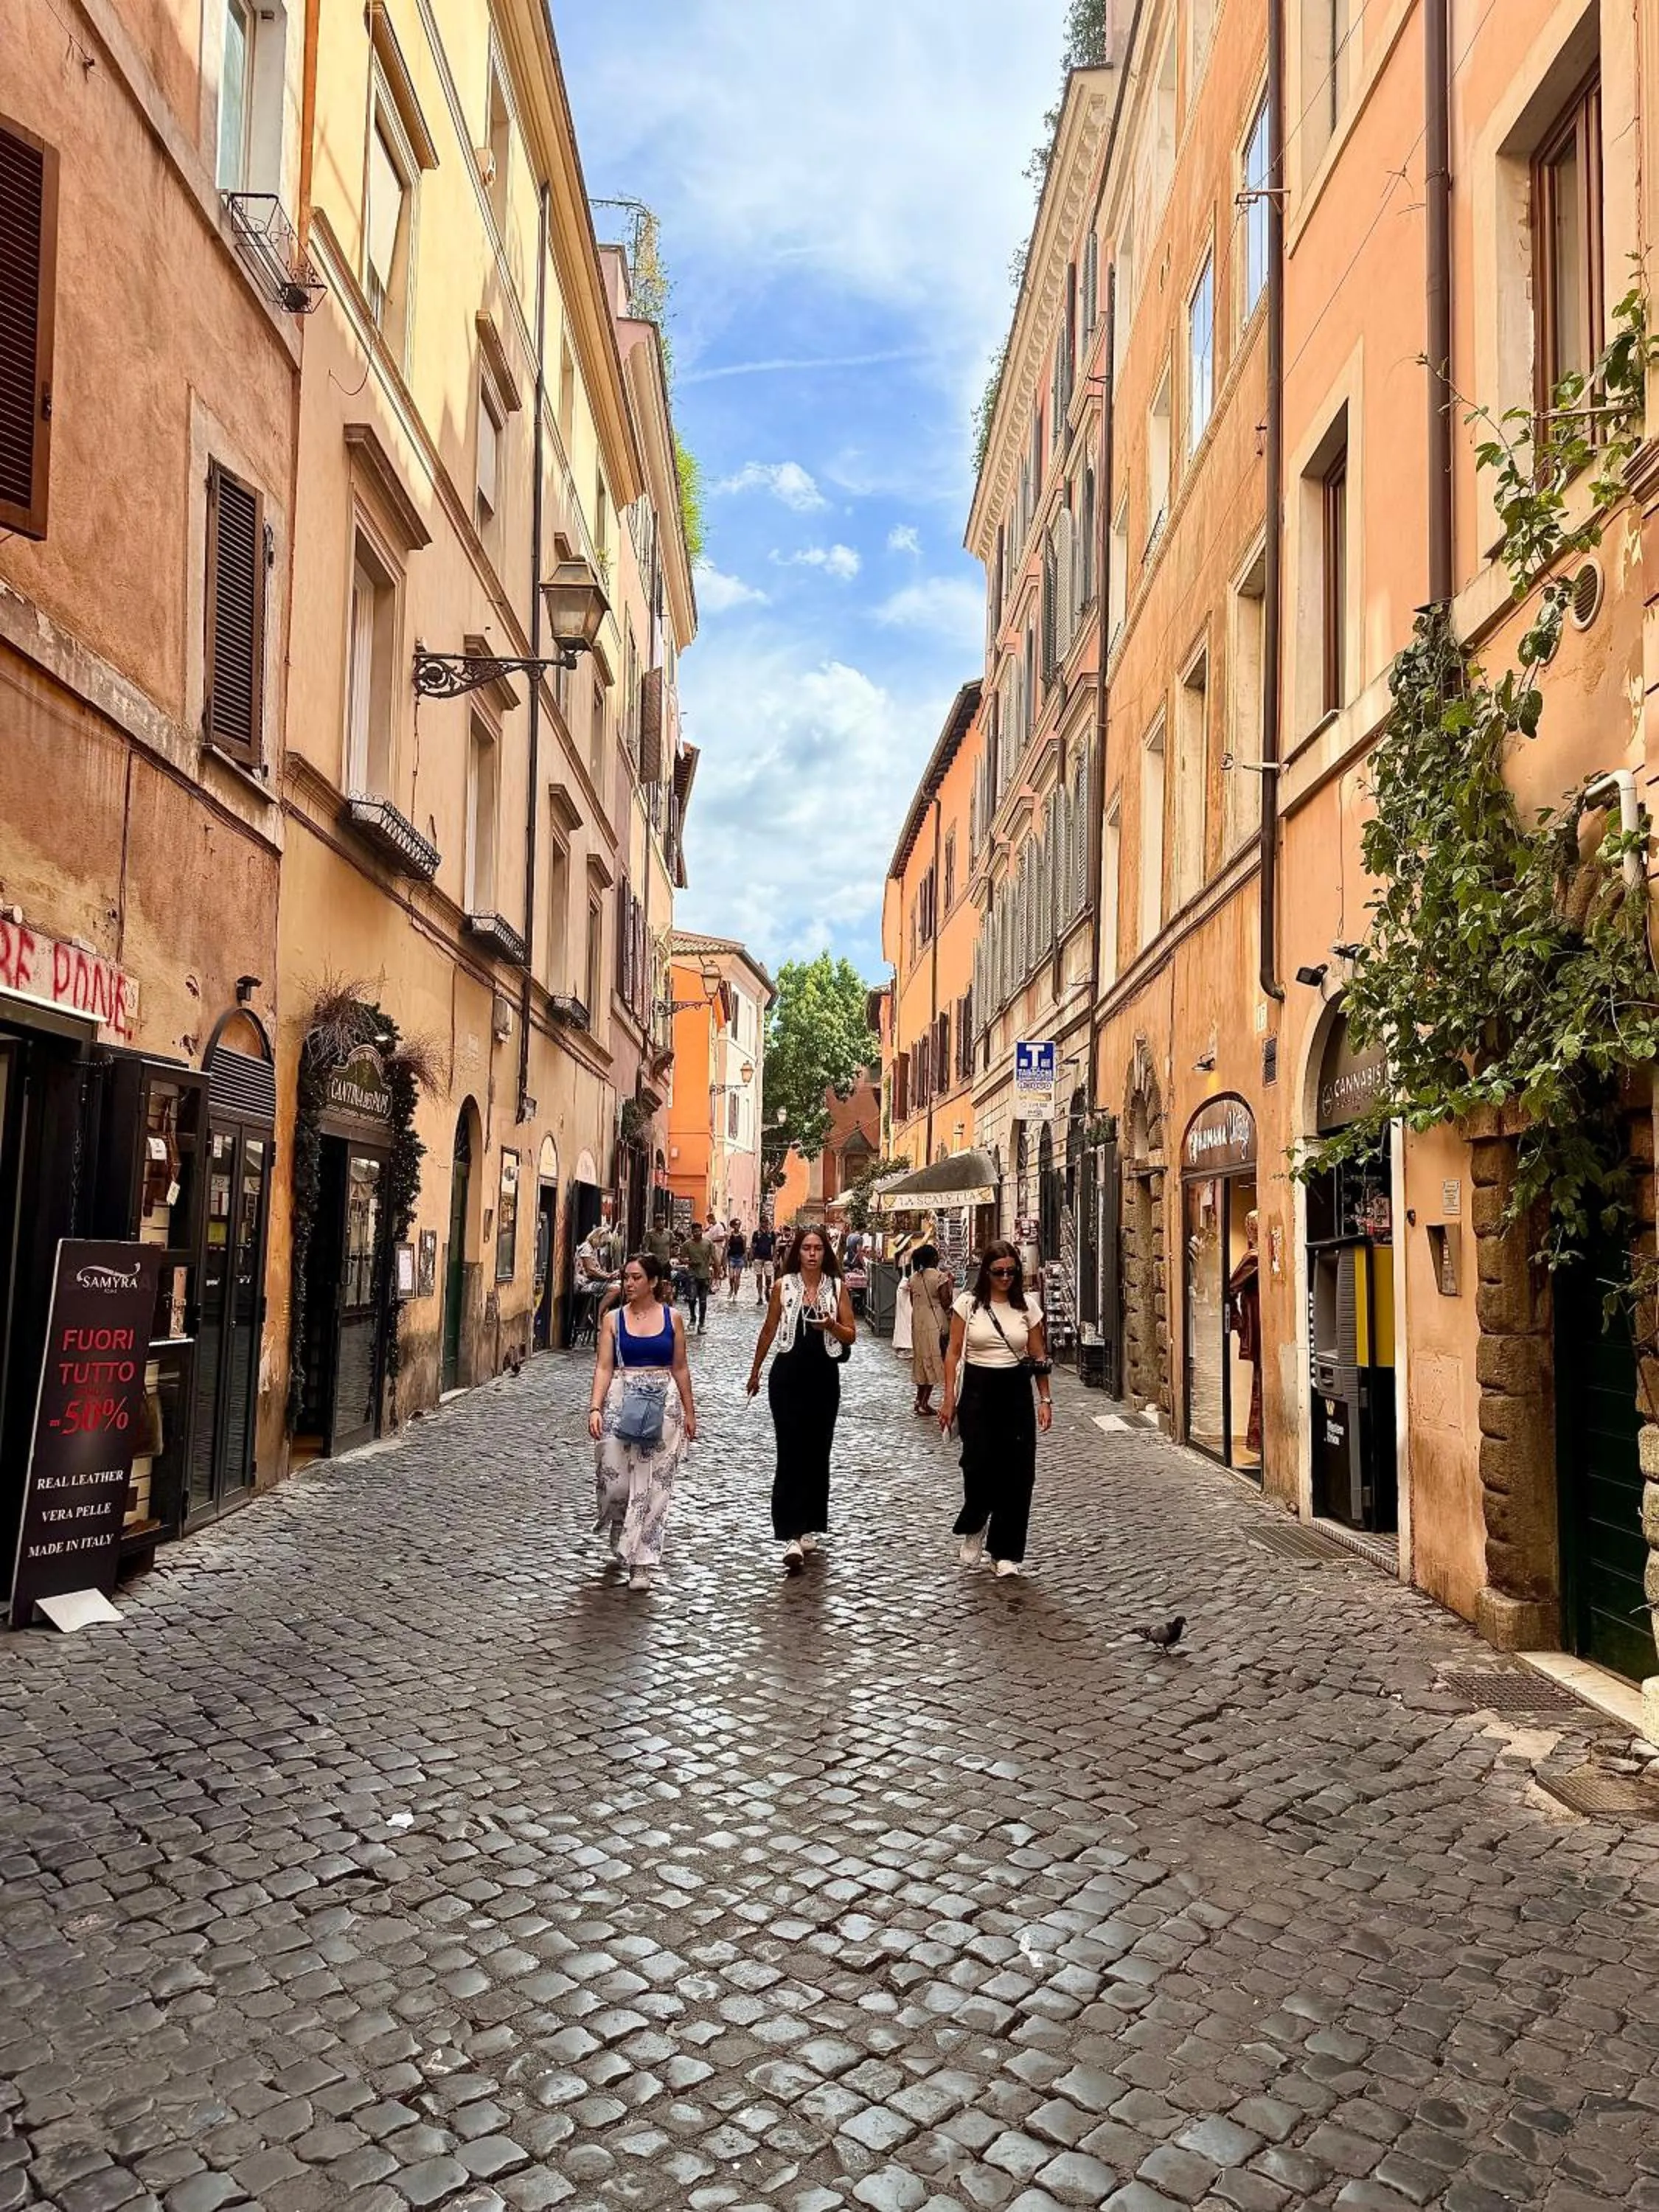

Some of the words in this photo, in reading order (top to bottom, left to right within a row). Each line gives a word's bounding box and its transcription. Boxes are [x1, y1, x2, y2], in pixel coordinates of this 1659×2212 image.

[82, 1275, 138, 1289] SAMYRA
[63, 1329, 134, 1352] FUORI
[59, 1361, 135, 1385] TUTTO
[49, 1396, 129, 1435] -50%
[37, 1475, 70, 1490] REAL
[72, 1470, 124, 1486] LEATHER
[42, 1508, 74, 1523] VERA
[75, 1502, 112, 1519] PELLE
[27, 1542, 65, 1558] MADE
[66, 1538, 80, 1552] IN
[80, 1533, 115, 1550] ITALY
